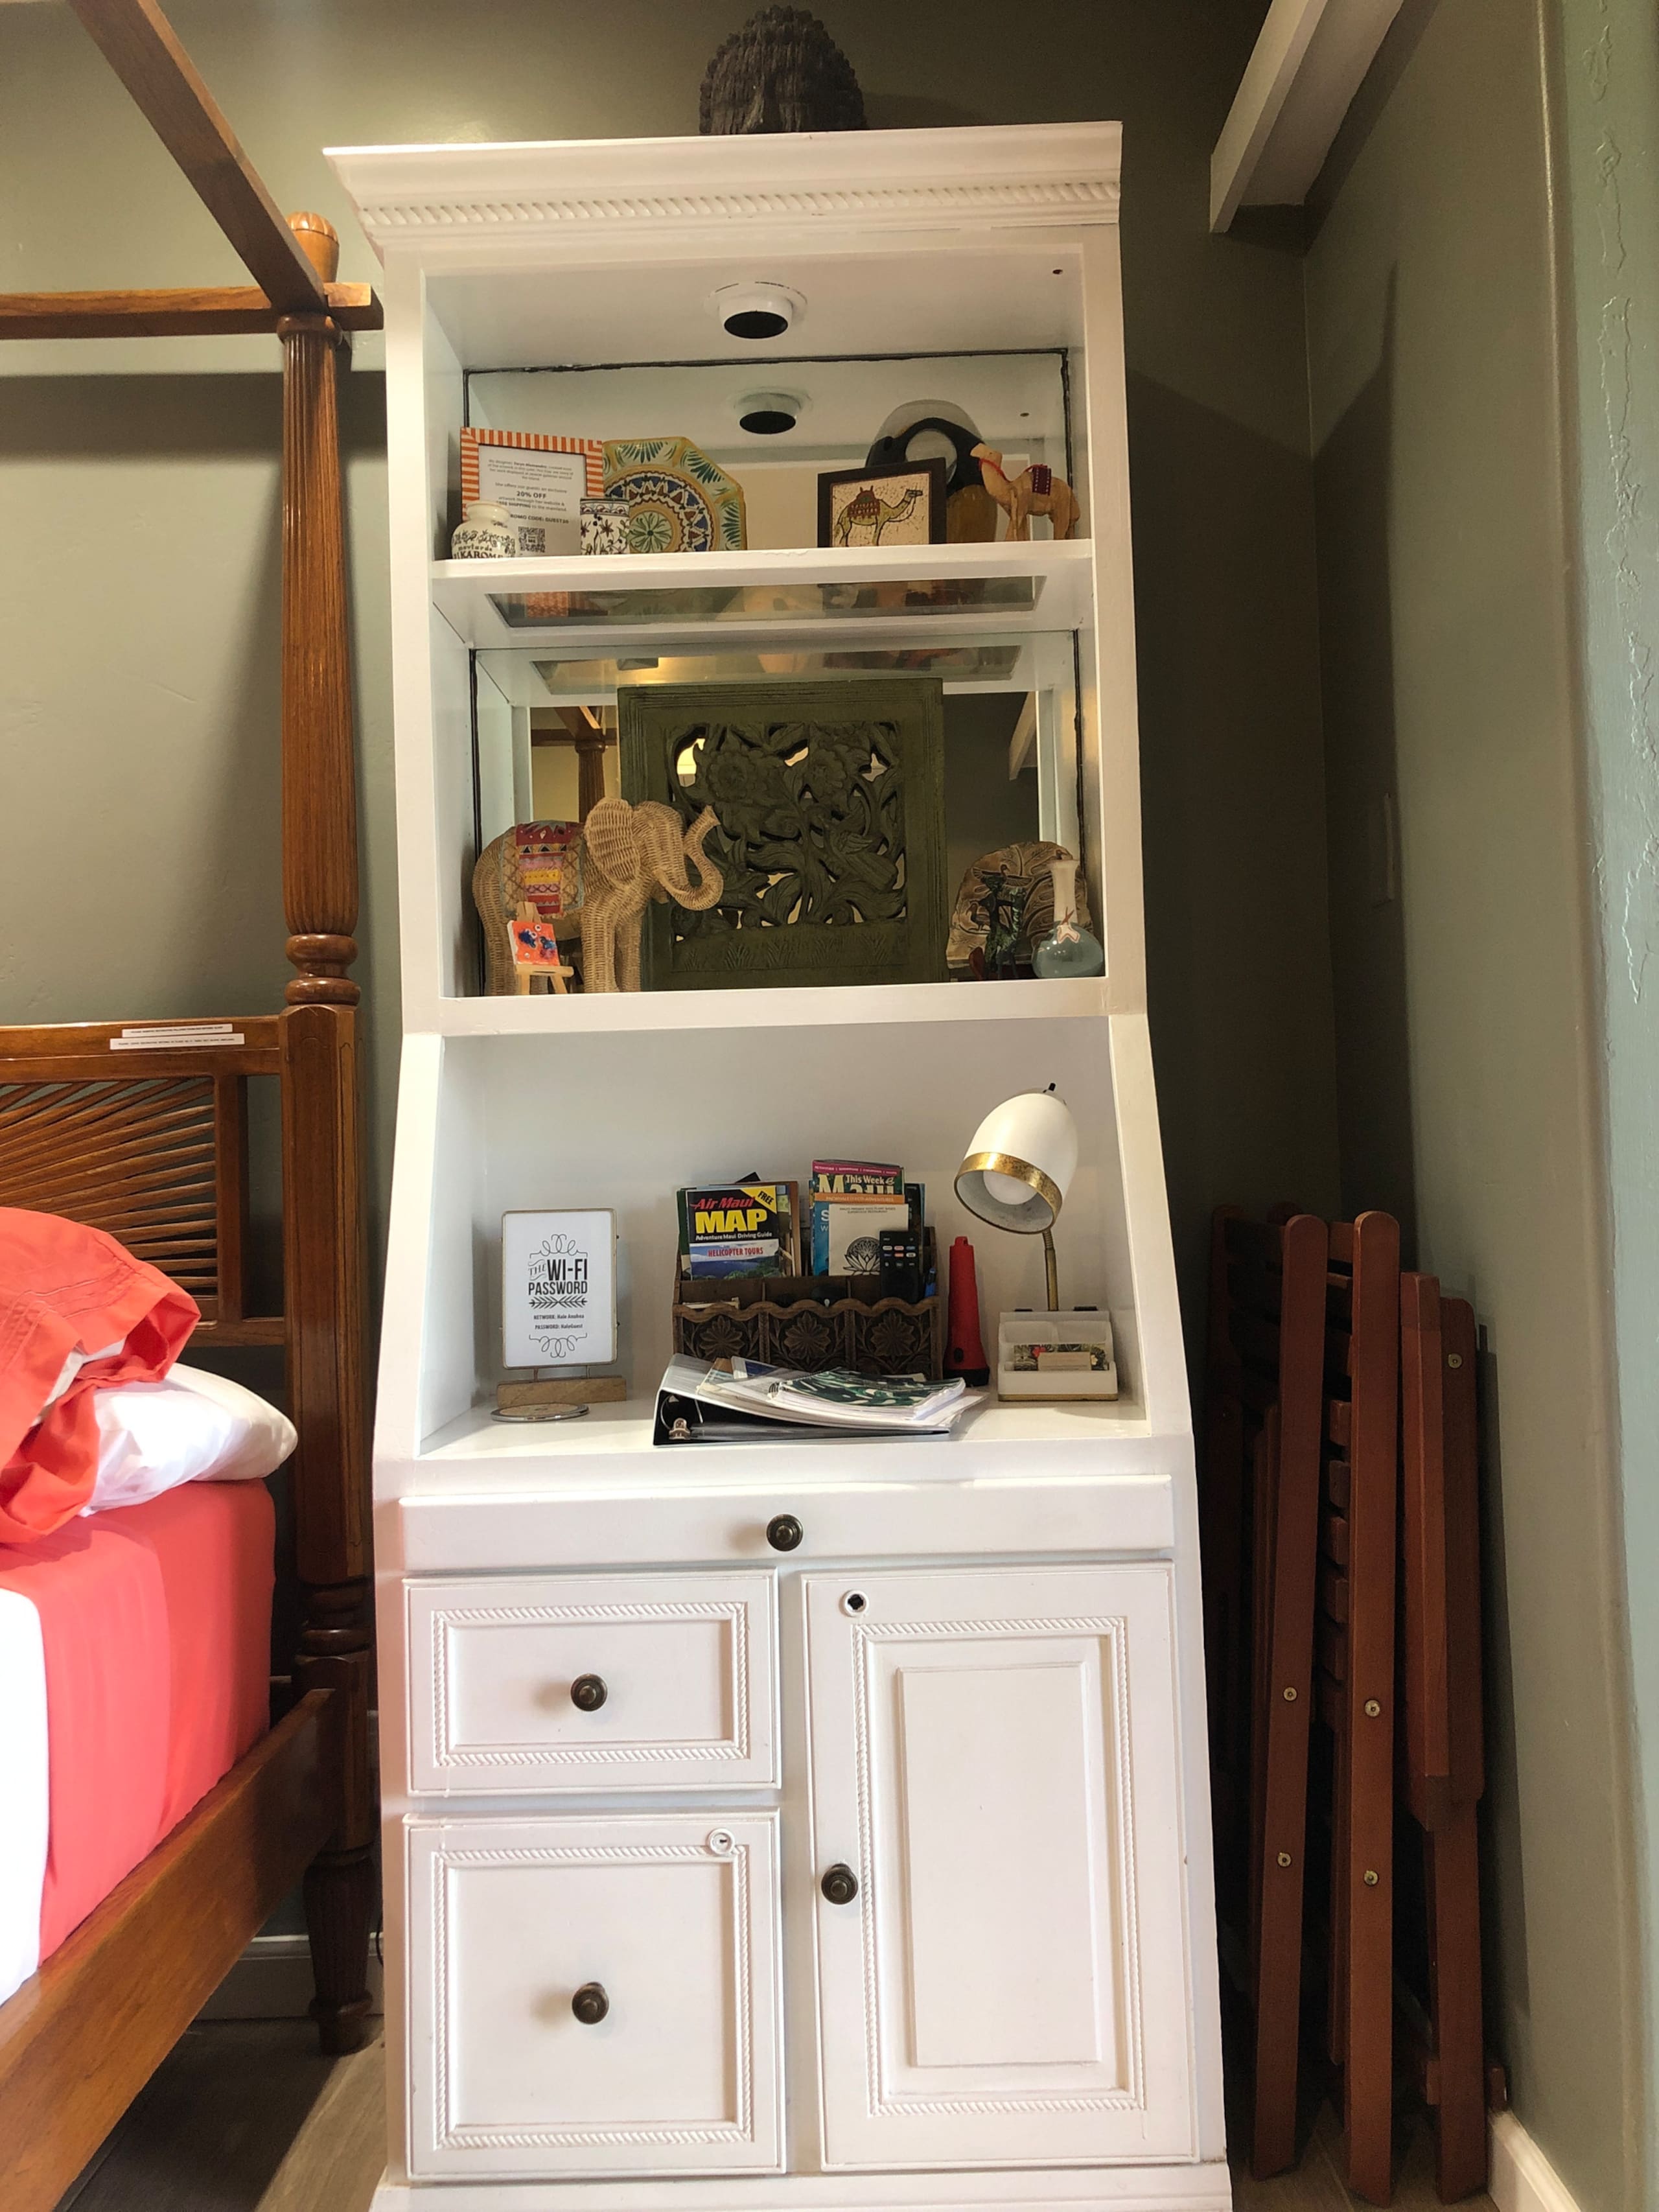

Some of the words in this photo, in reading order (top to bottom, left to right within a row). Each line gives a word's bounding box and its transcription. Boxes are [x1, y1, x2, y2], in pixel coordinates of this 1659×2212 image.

[846, 1174, 863, 1183] This
[863, 1175, 885, 1185] Week
[692, 1198, 718, 1209] Air
[719, 1196, 756, 1209] Maui
[758, 1190, 774, 1205] FREE
[695, 1209, 767, 1234] MAP
[708, 1248, 743, 1257] HELICOPTER
[745, 1247, 763, 1255] TOURS
[528, 1263, 546, 1276] THE
[547, 1259, 587, 1281] WI-FI
[528, 1281, 587, 1295] PASSWORD
